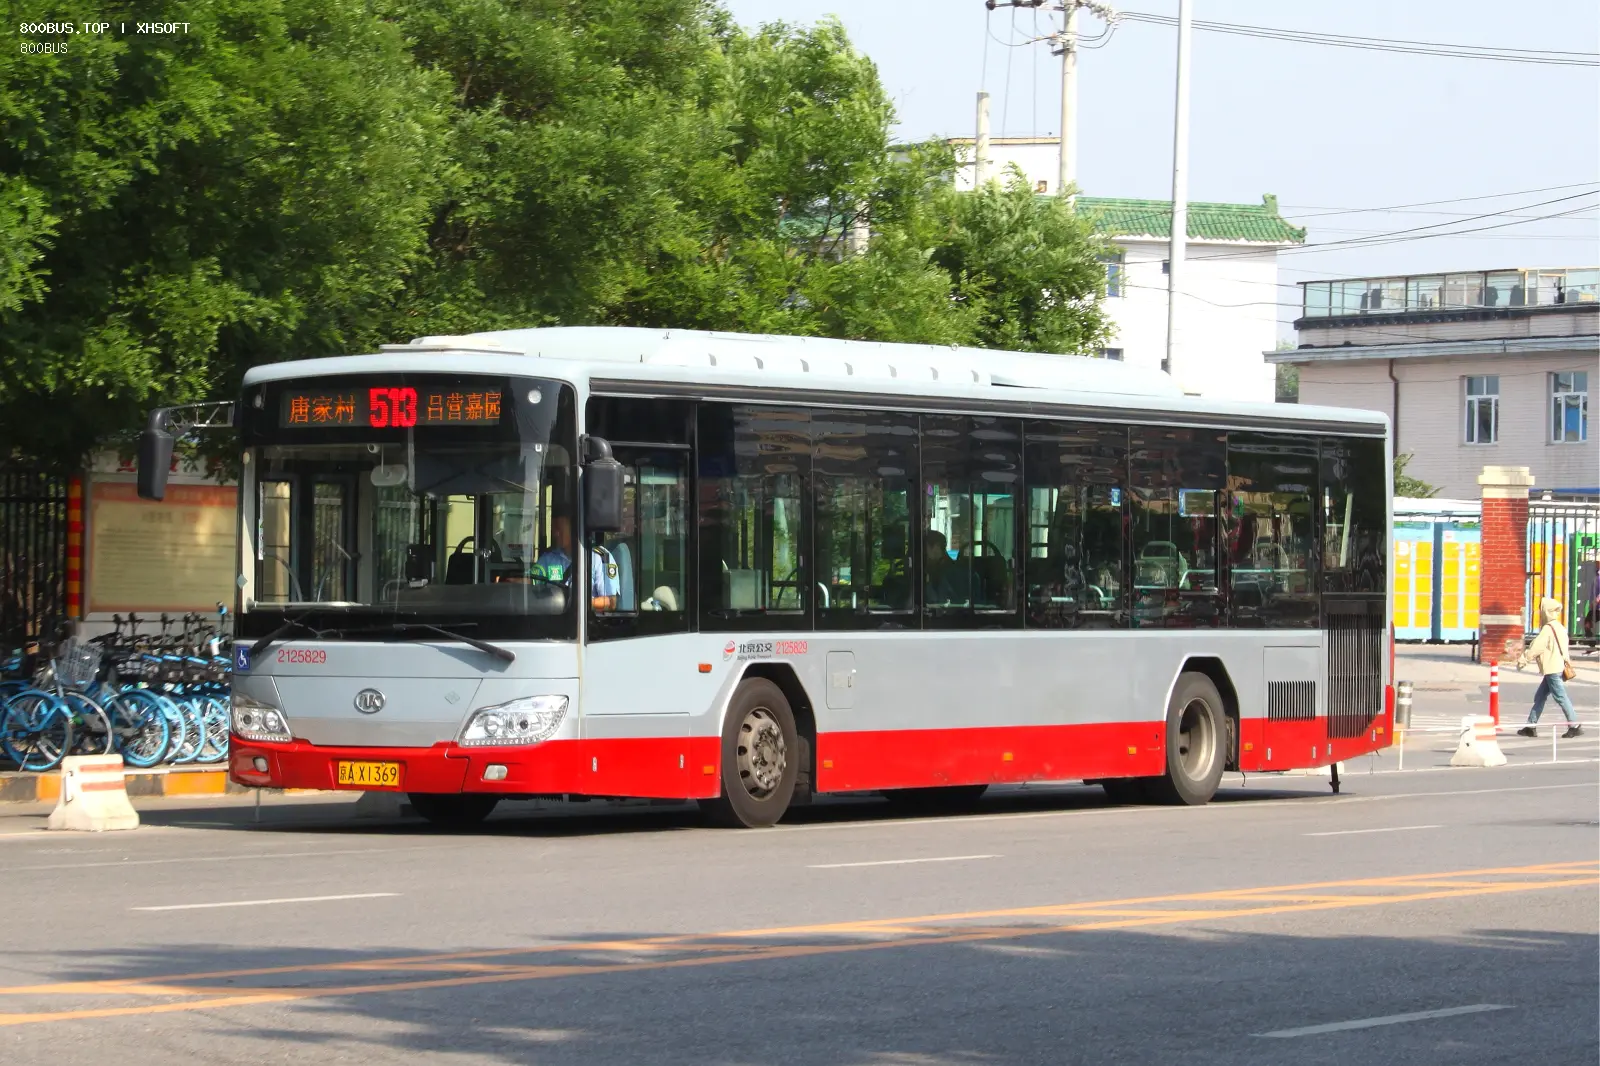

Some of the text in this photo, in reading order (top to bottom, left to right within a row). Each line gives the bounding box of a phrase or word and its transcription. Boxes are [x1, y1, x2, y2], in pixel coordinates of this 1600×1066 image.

[289, 395, 355, 423] 唐家村
[369, 387, 418, 427] 513
[738, 643, 772, 653] 北京公交
[776, 641, 807, 654] 2125829
[277, 650, 326, 663] 2125829
